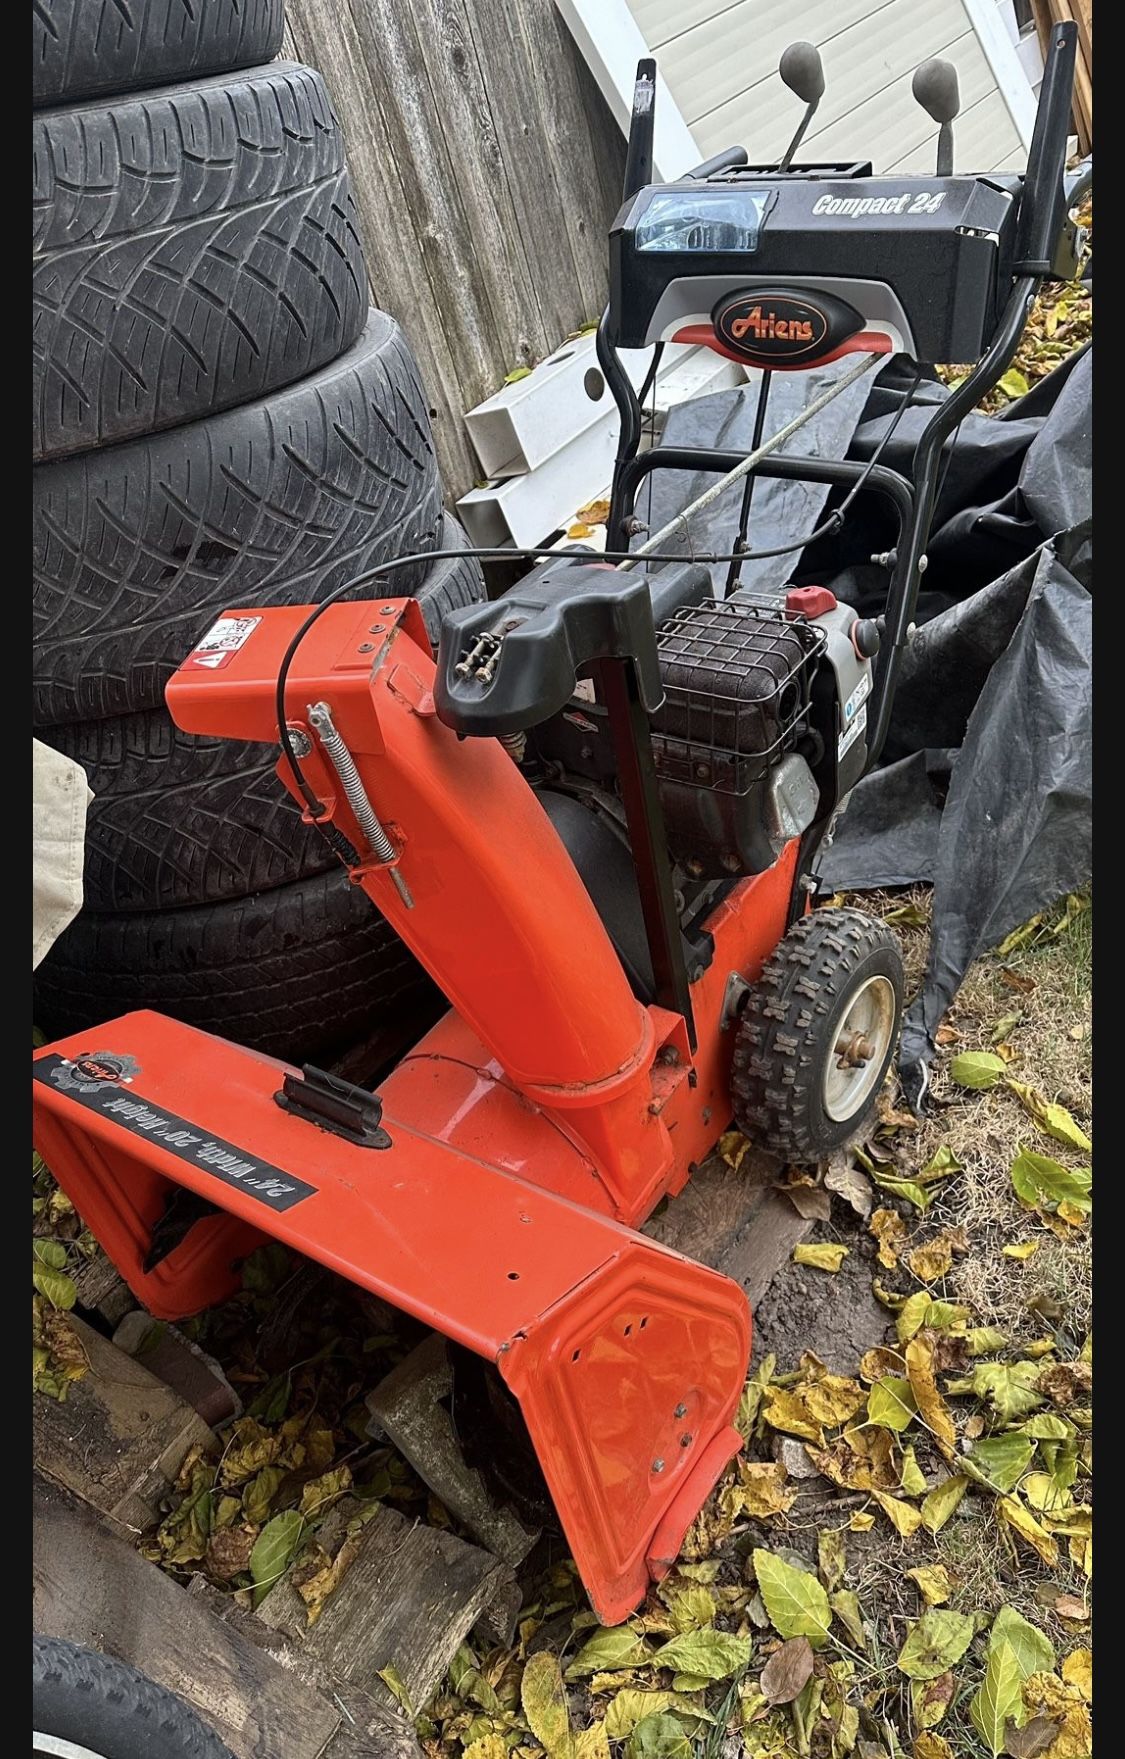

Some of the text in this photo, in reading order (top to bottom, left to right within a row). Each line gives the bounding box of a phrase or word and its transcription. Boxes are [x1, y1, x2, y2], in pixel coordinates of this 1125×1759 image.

[812, 192, 947, 219] Compact 24
[731, 305, 814, 341] Ariens
[102, 1097, 169, 1130] Height
